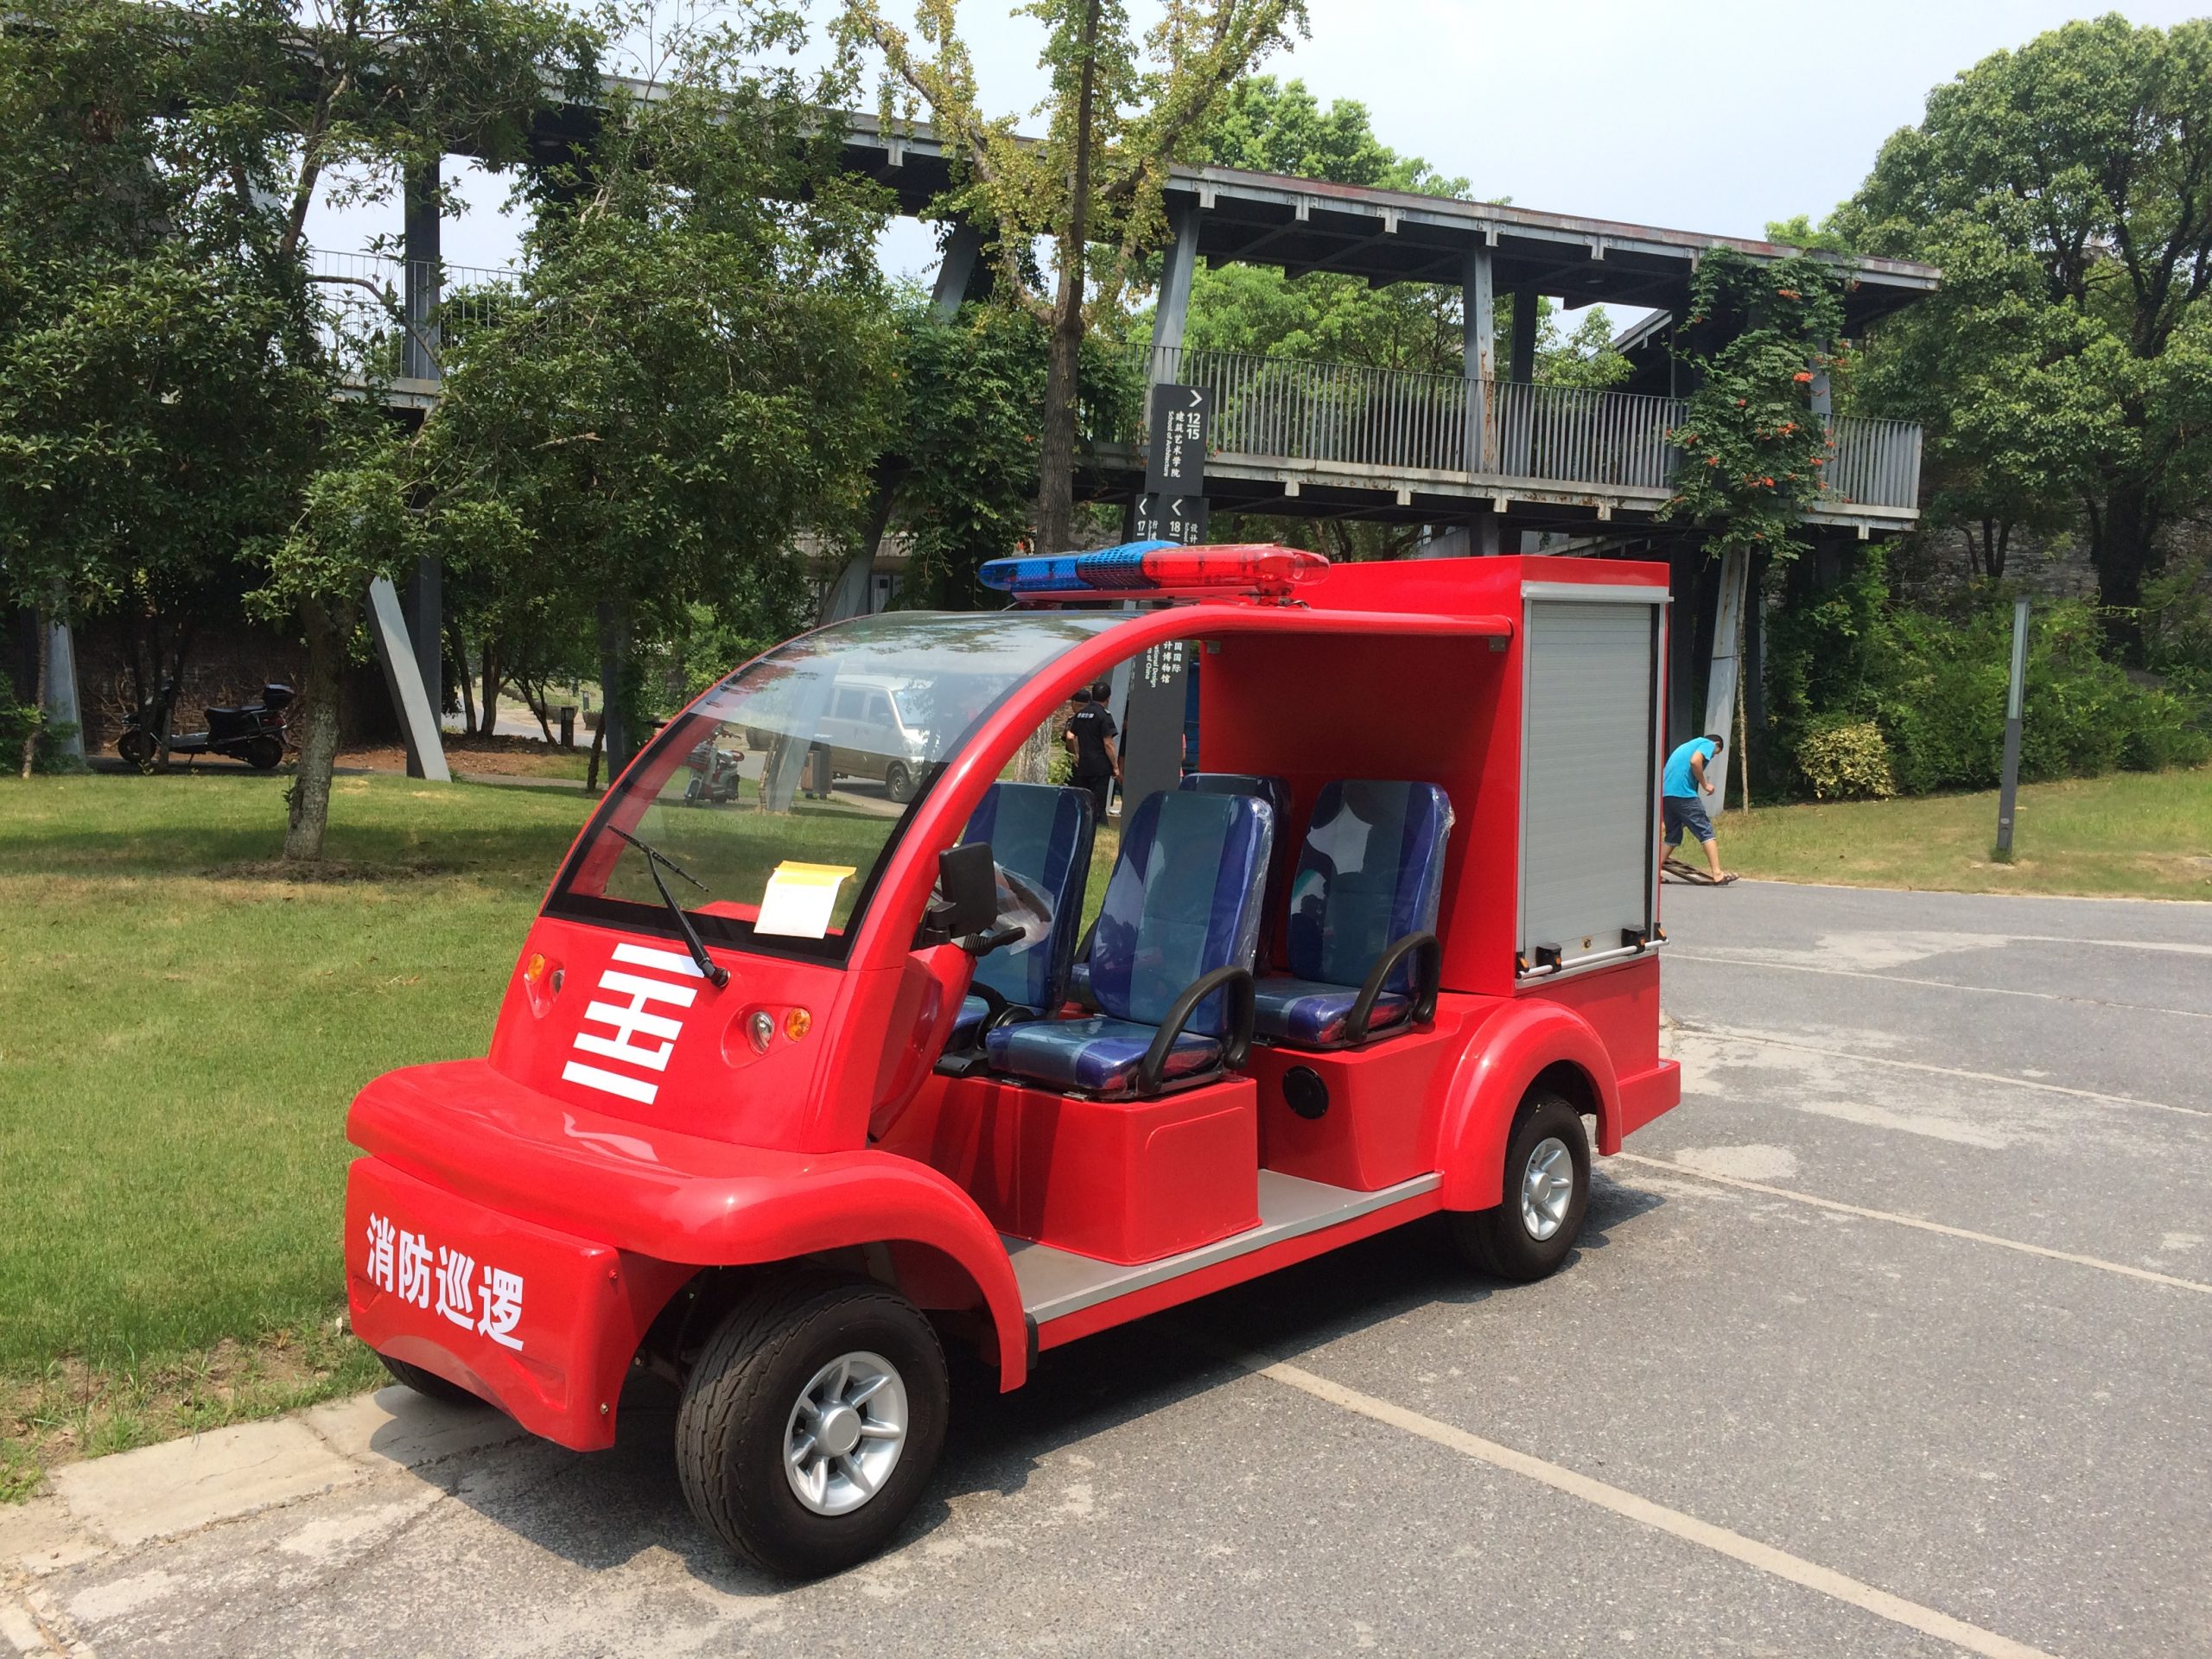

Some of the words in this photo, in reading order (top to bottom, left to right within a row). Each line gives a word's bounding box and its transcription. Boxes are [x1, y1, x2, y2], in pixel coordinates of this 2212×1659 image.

[1186, 412, 1201, 425] 12
[1171, 410, 1185, 477] 建筑艺术学院
[1186, 429, 1200, 440] 15
[1137, 520, 1146, 531] 17
[1169, 520, 1181, 532] 18
[1161, 640, 1173, 683] 计博物馆
[1172, 642, 1183, 673] 国国际
[366, 1211, 524, 1351] 消防巡逻
